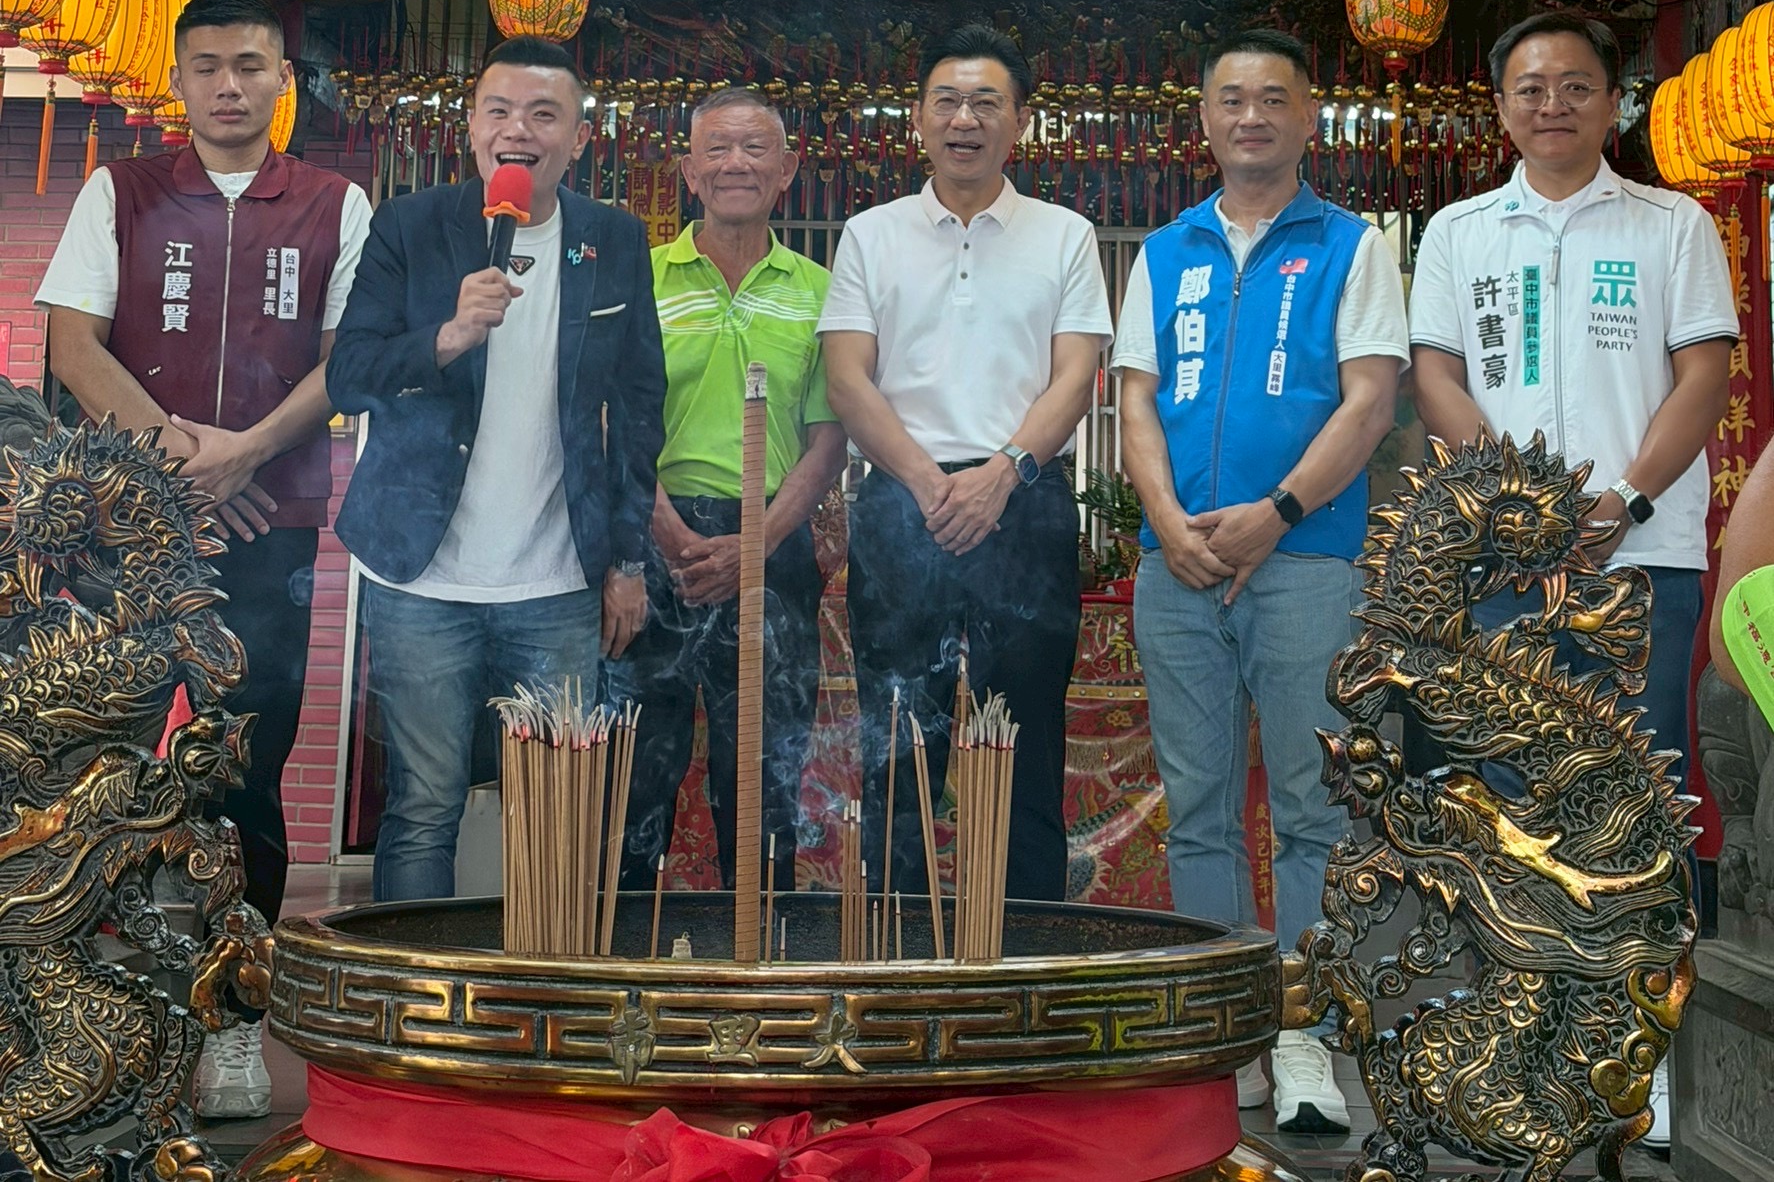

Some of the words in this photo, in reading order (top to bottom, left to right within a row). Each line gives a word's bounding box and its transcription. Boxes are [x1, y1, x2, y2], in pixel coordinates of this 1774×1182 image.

[284, 252, 296, 278] 台中
[161, 241, 194, 333] 江慶賢
[1506, 270, 1520, 316] 太平區
[262, 286, 277, 316] 里長
[282, 289, 295, 314] 大里
[1588, 325, 1638, 339] PEOPLE'S
[1590, 312, 1638, 326] TAIWAN
[1471, 275, 1508, 390] 許書豪
[1596, 339, 1634, 352] PARTY
